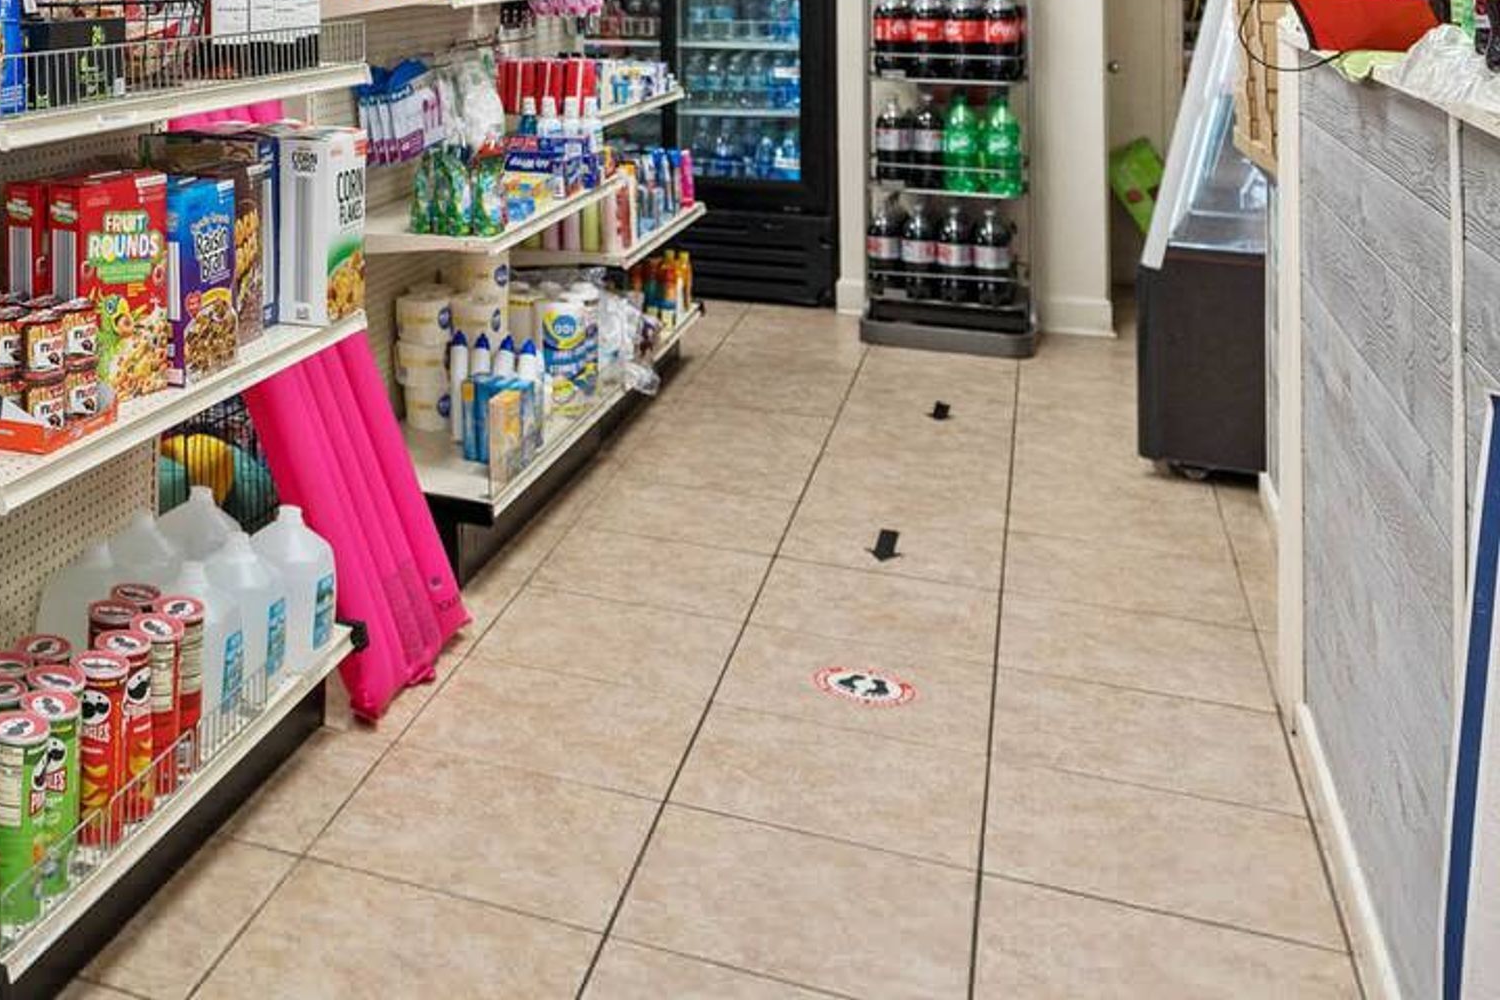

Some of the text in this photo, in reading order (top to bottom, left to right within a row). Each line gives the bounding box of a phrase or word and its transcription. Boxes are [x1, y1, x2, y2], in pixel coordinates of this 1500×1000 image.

[336, 166, 363, 204] CORN
[106, 214, 146, 232] FRUIT
[88, 234, 160, 259] ROUNDS
